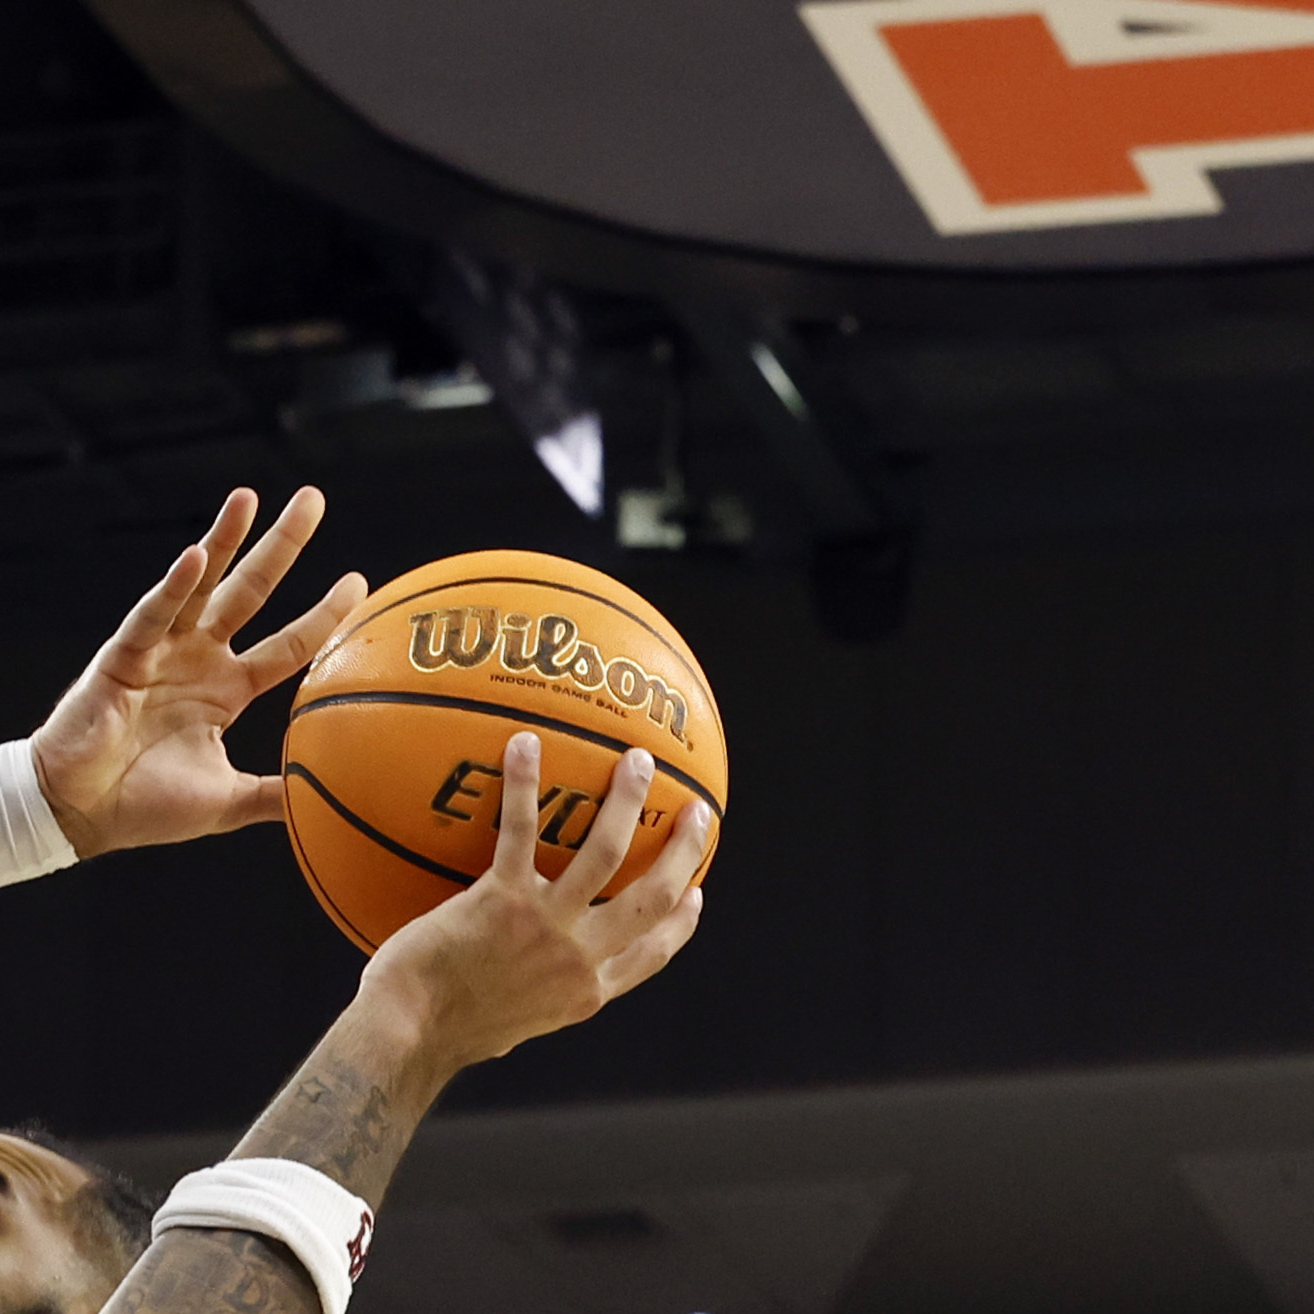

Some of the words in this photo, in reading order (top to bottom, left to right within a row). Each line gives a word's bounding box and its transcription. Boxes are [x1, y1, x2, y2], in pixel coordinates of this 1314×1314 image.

[409, 606, 689, 744] Wilson
[489, 673, 547, 690] INDOOR
[551, 684, 592, 703] GAME
[596, 698, 629, 719] BALL
